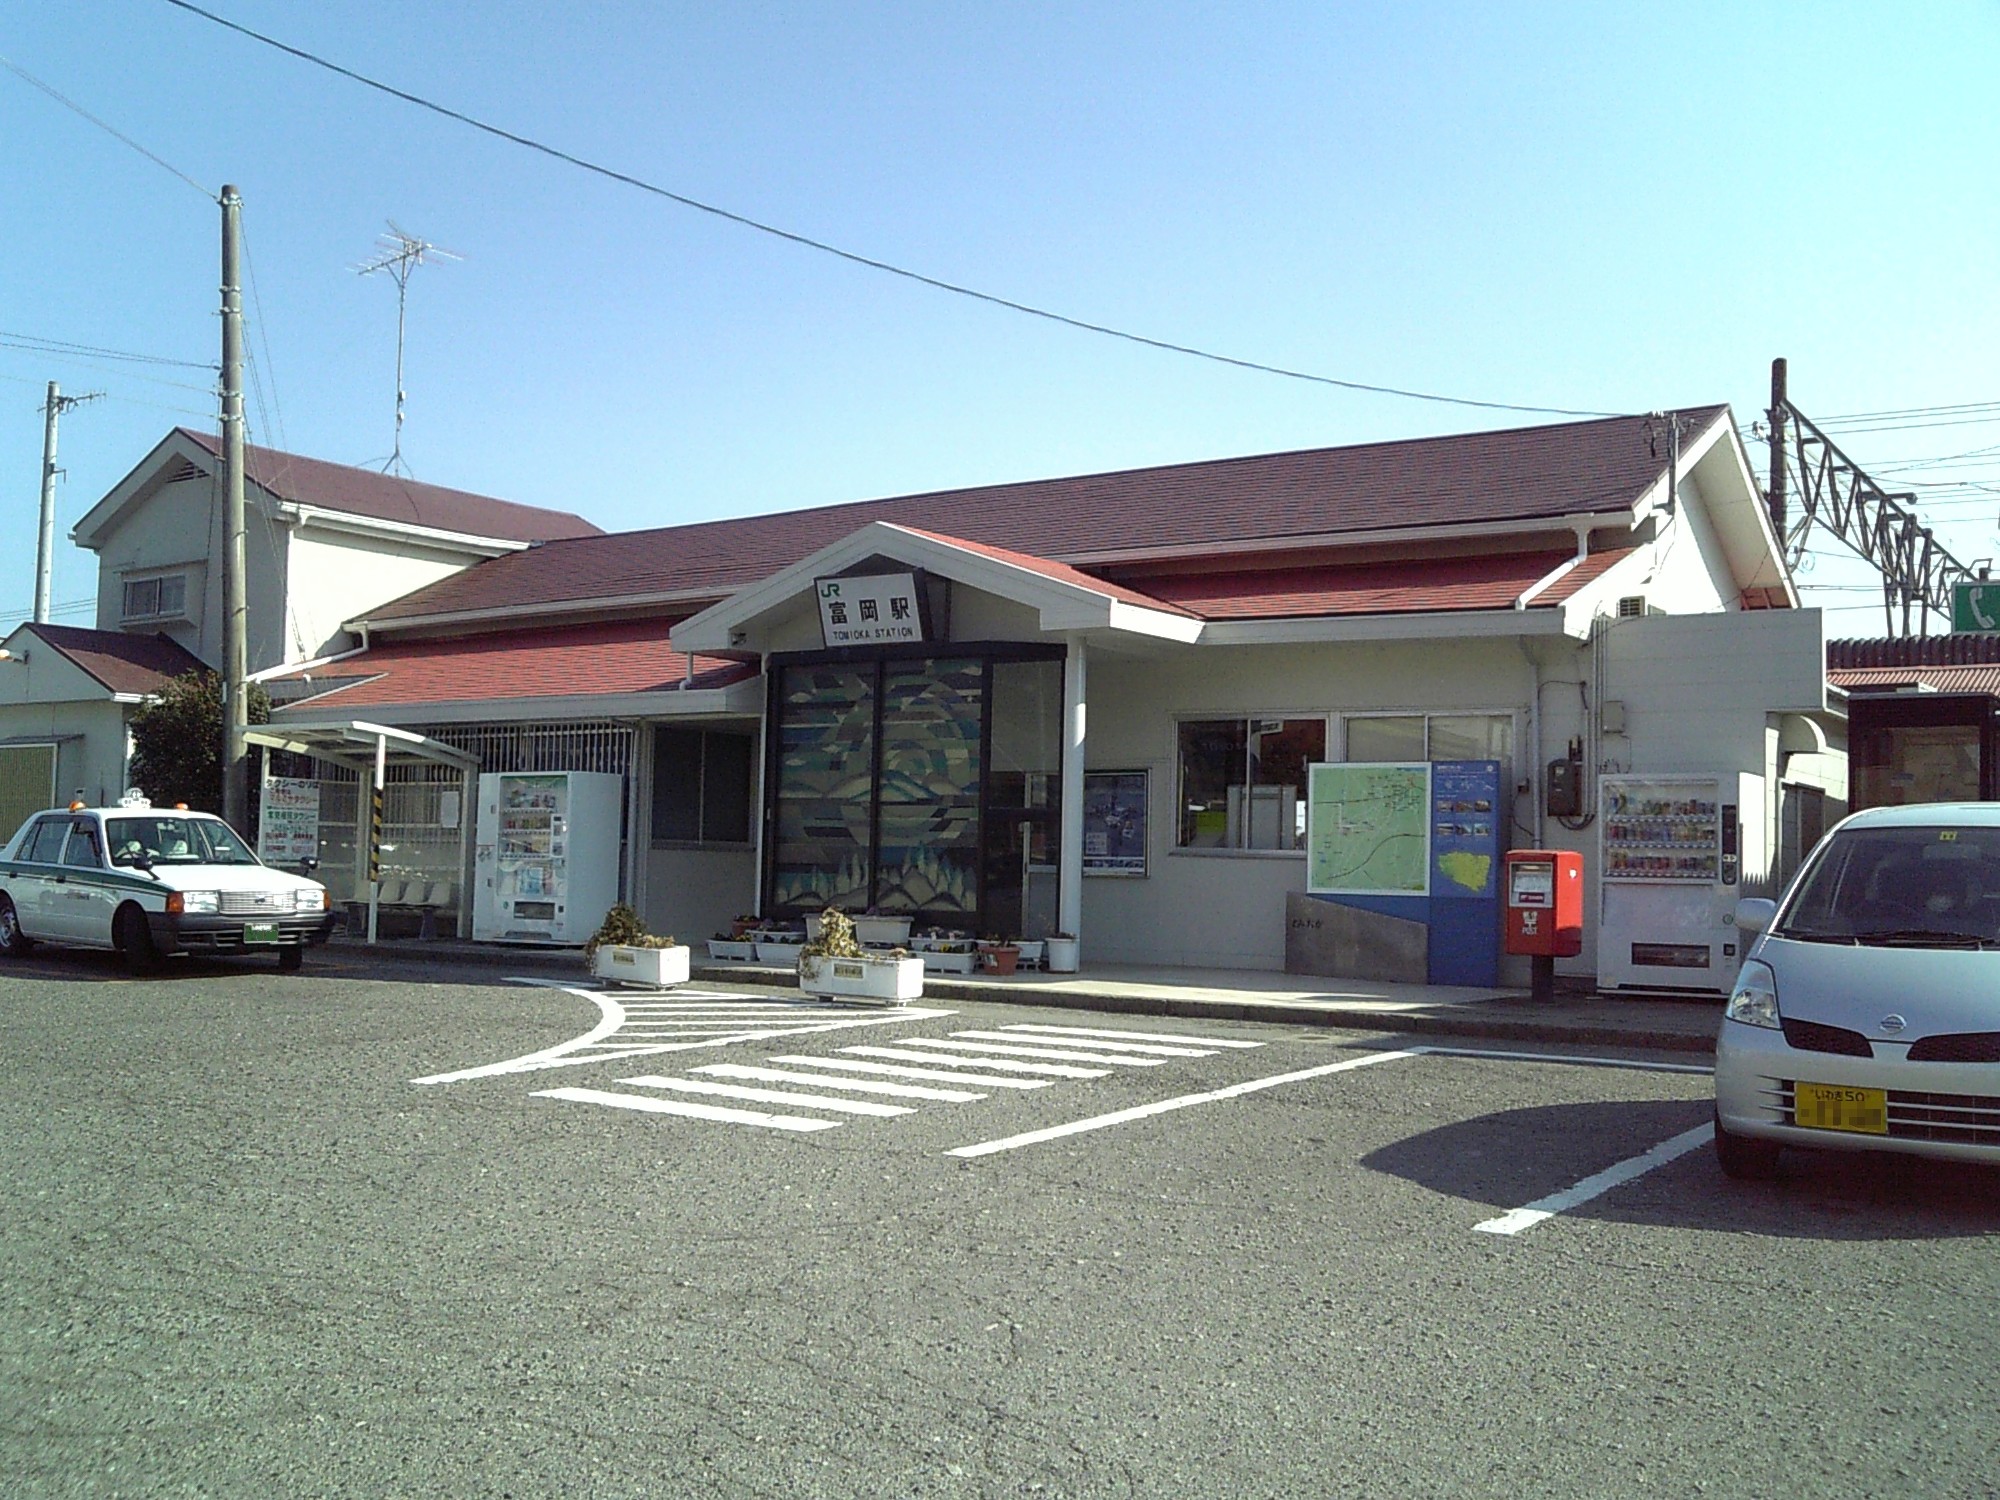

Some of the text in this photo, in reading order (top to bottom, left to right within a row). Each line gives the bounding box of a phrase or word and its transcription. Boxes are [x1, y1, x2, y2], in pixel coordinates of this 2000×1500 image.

[820, 583, 841, 598] JR
[828, 597, 911, 625] 富岡駅
[833, 627, 913, 641] TOMIOKA STATION
[1814, 1089, 1843, 1101] いわき
